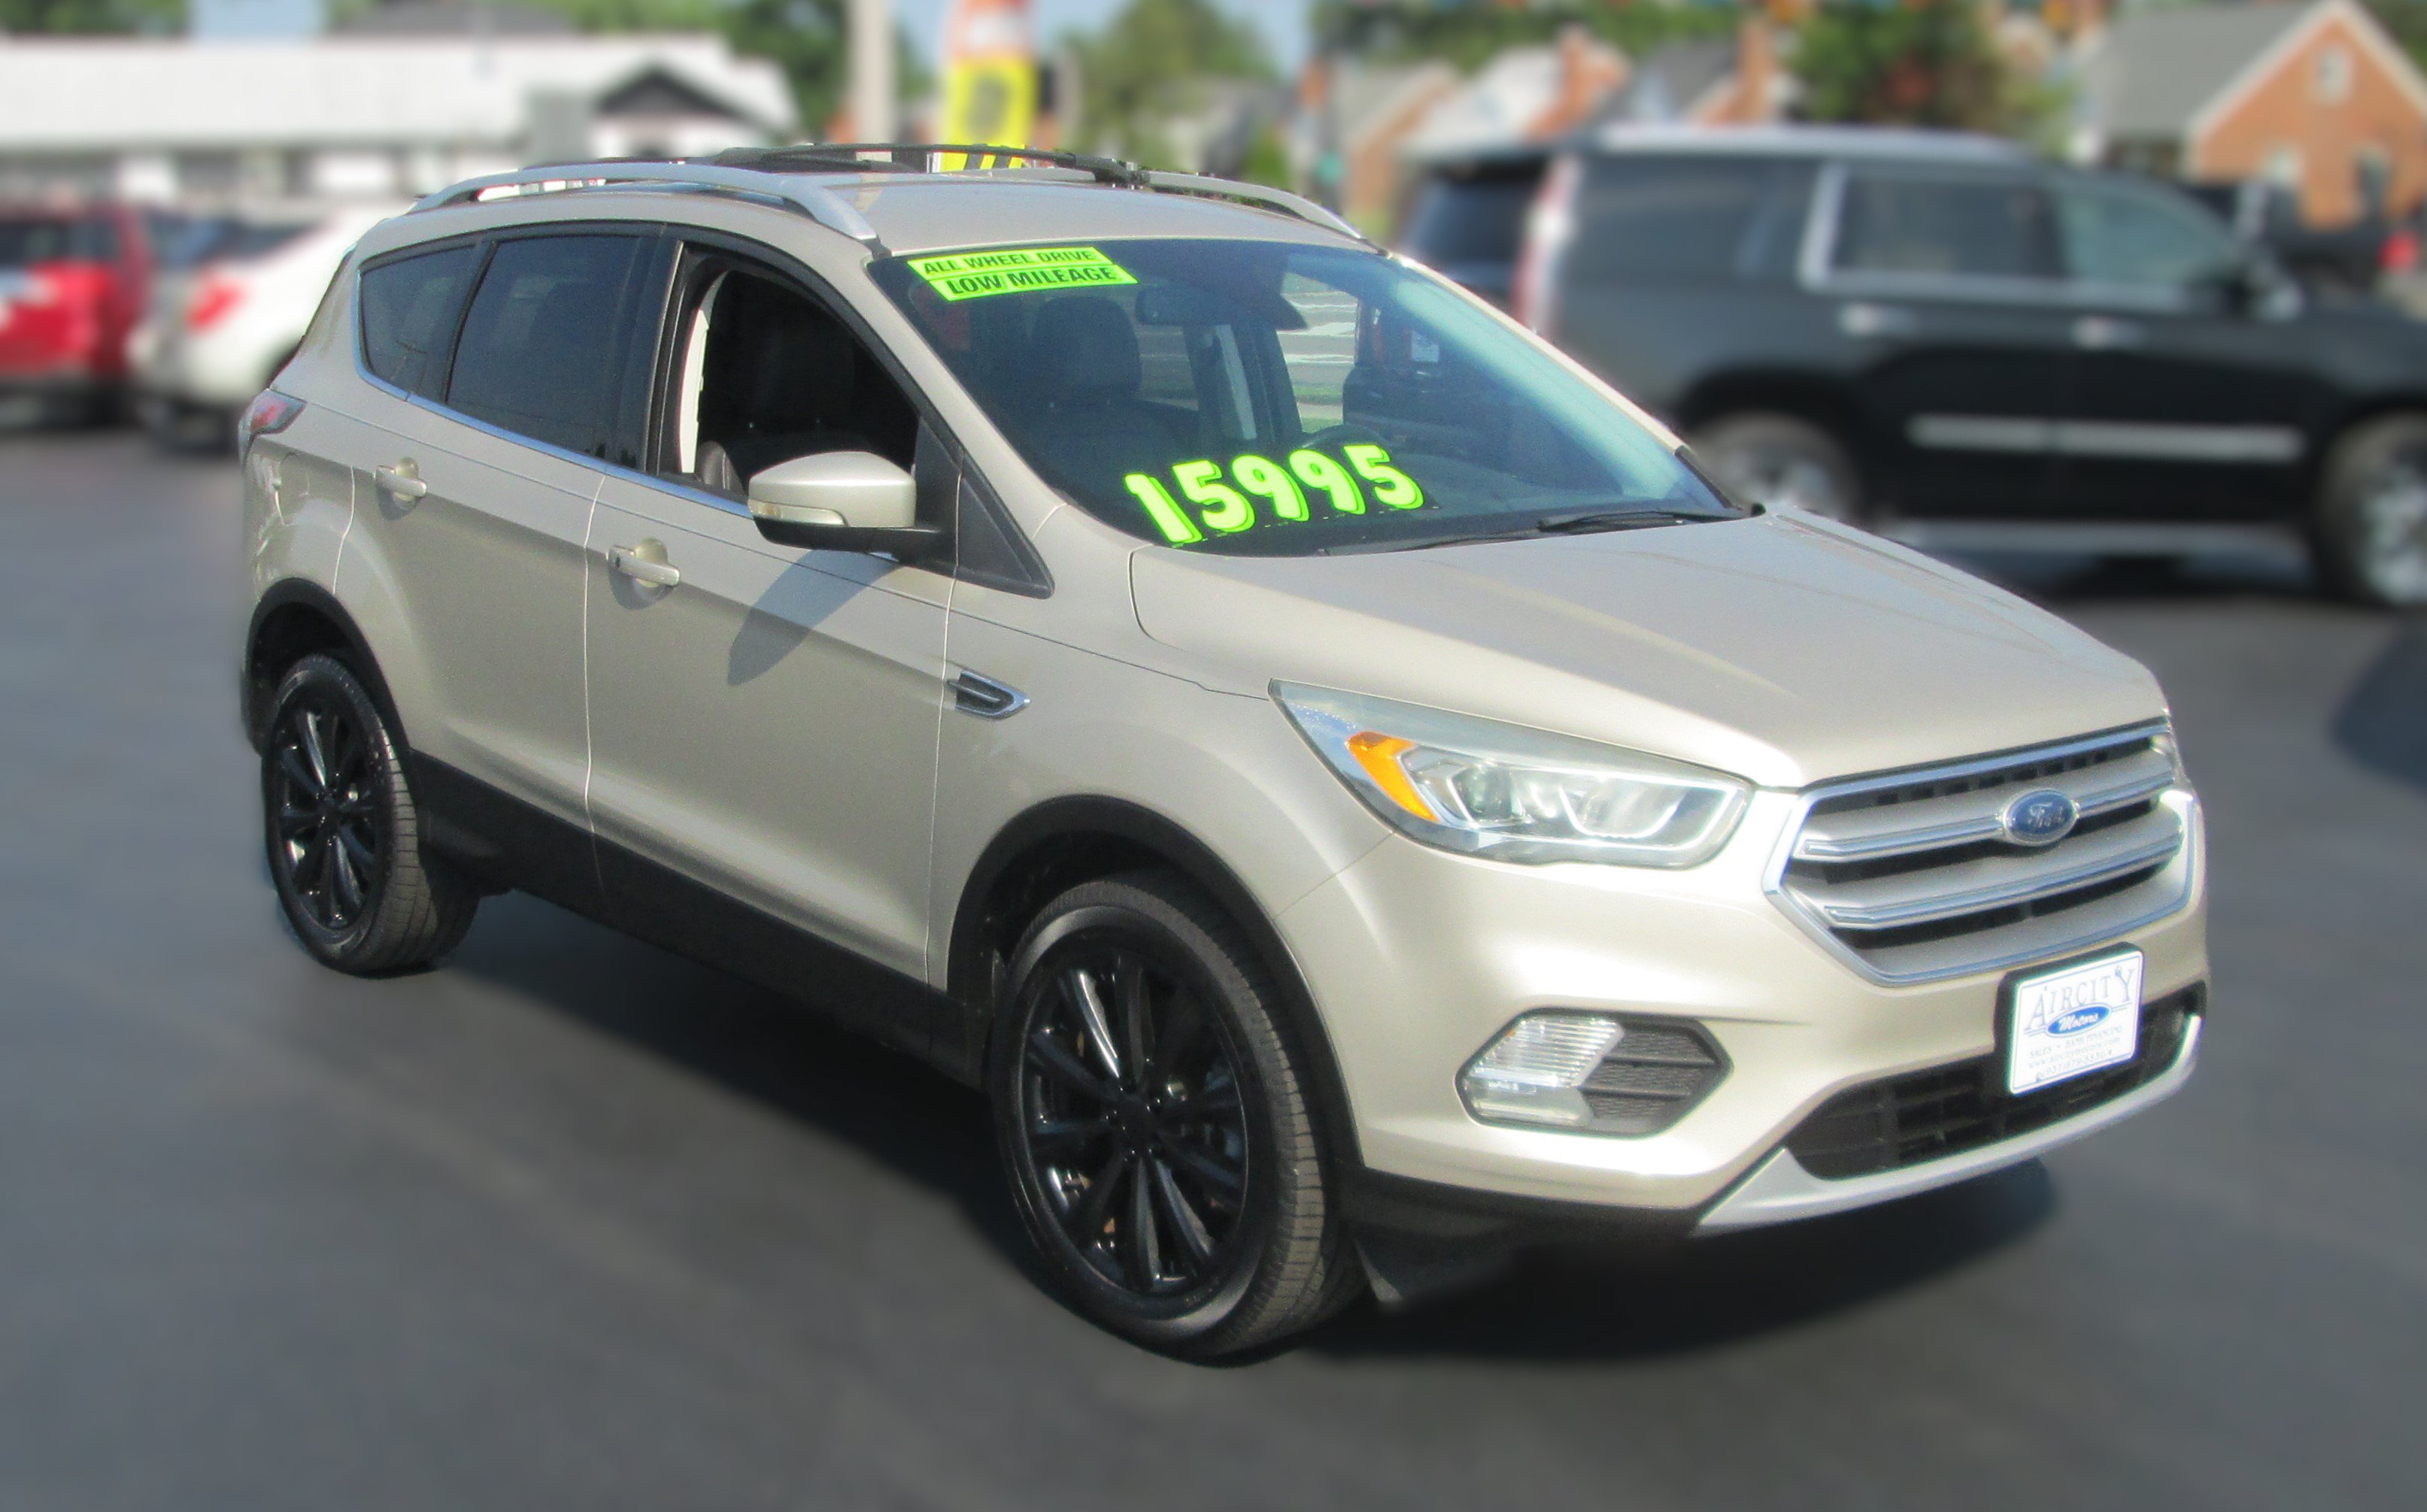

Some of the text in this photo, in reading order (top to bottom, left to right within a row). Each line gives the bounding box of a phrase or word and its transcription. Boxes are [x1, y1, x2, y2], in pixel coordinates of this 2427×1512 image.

[924, 250, 1096, 274] ALL WHEEL DRIVE
[945, 266, 1116, 295] LOW MILEAGE
[1124, 444, 1424, 544] 15995
[2023, 966, 2136, 1031] AIRCITY
